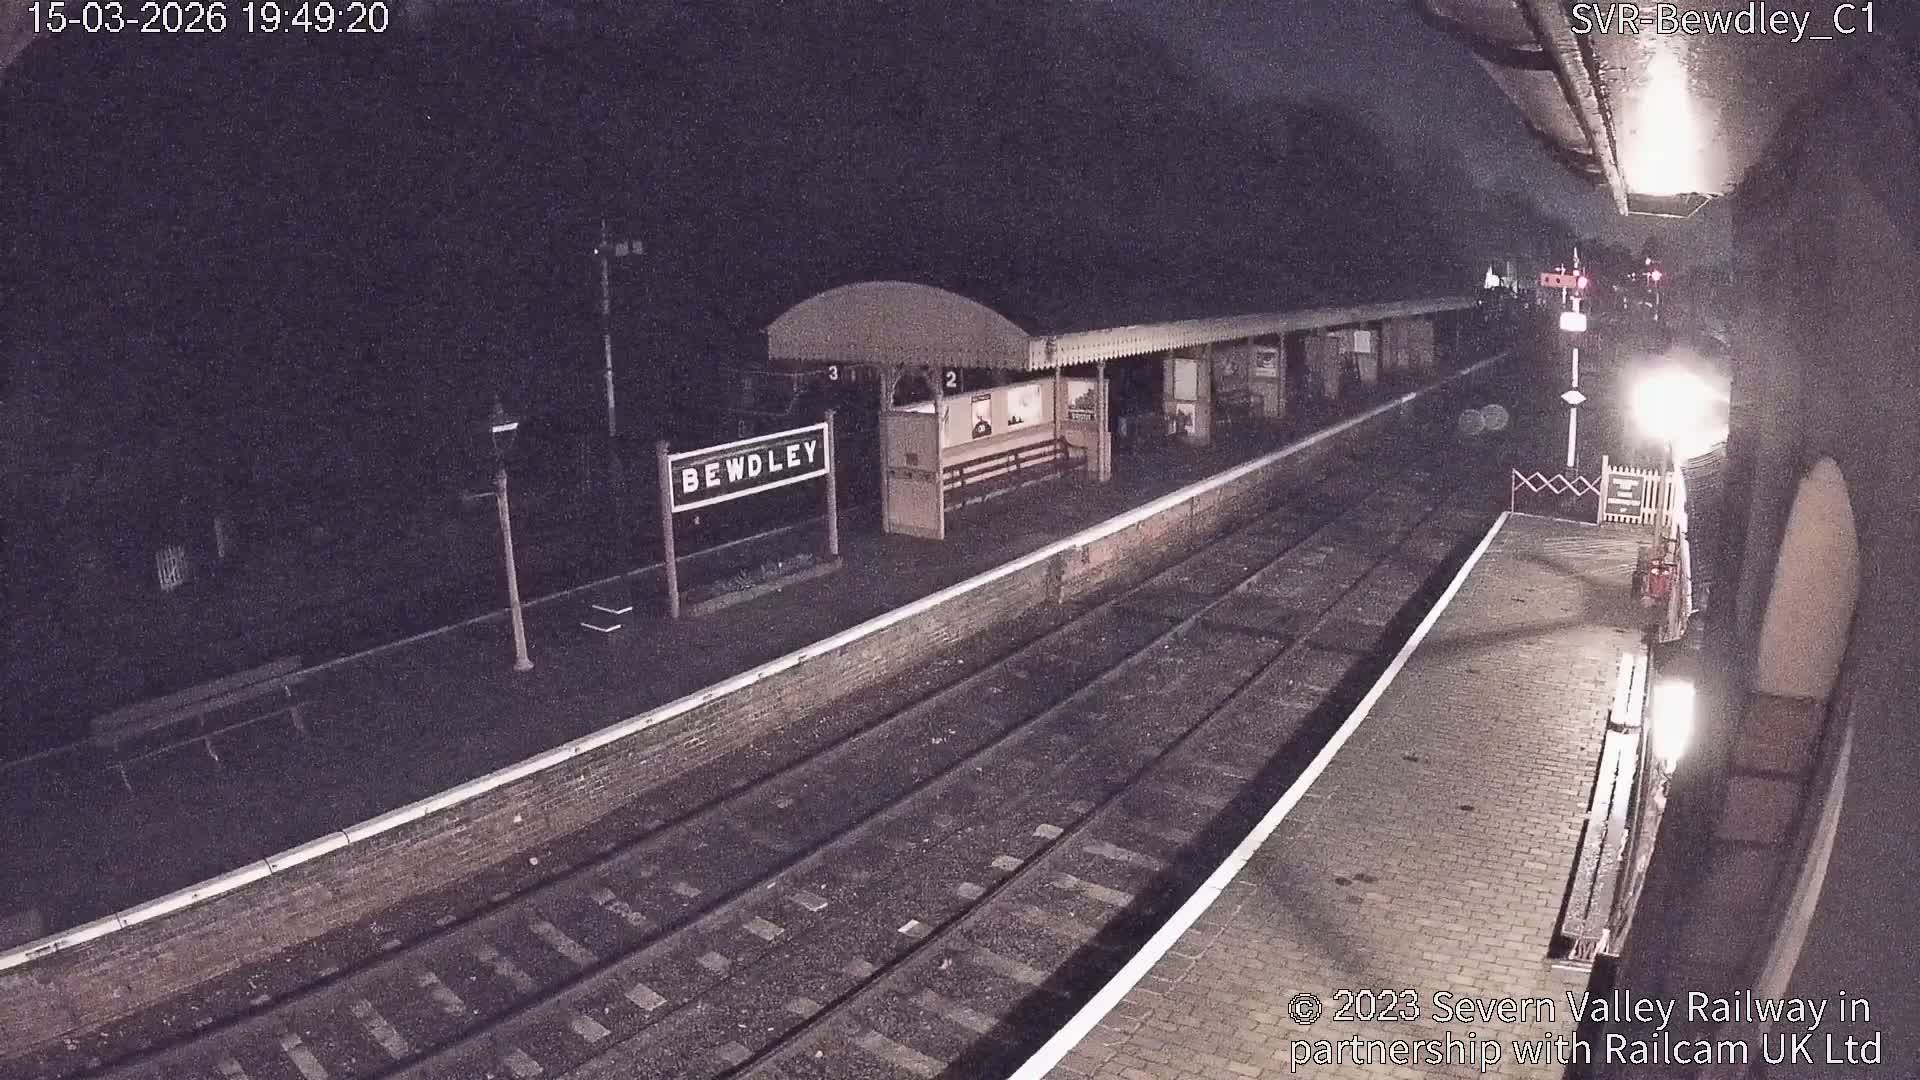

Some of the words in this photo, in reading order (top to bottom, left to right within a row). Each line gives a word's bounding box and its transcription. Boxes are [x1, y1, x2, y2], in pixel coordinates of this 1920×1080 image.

[828, 365, 839, 381] 3
[946, 371, 957, 388] 2
[682, 440, 817, 494] BEWDLEY
